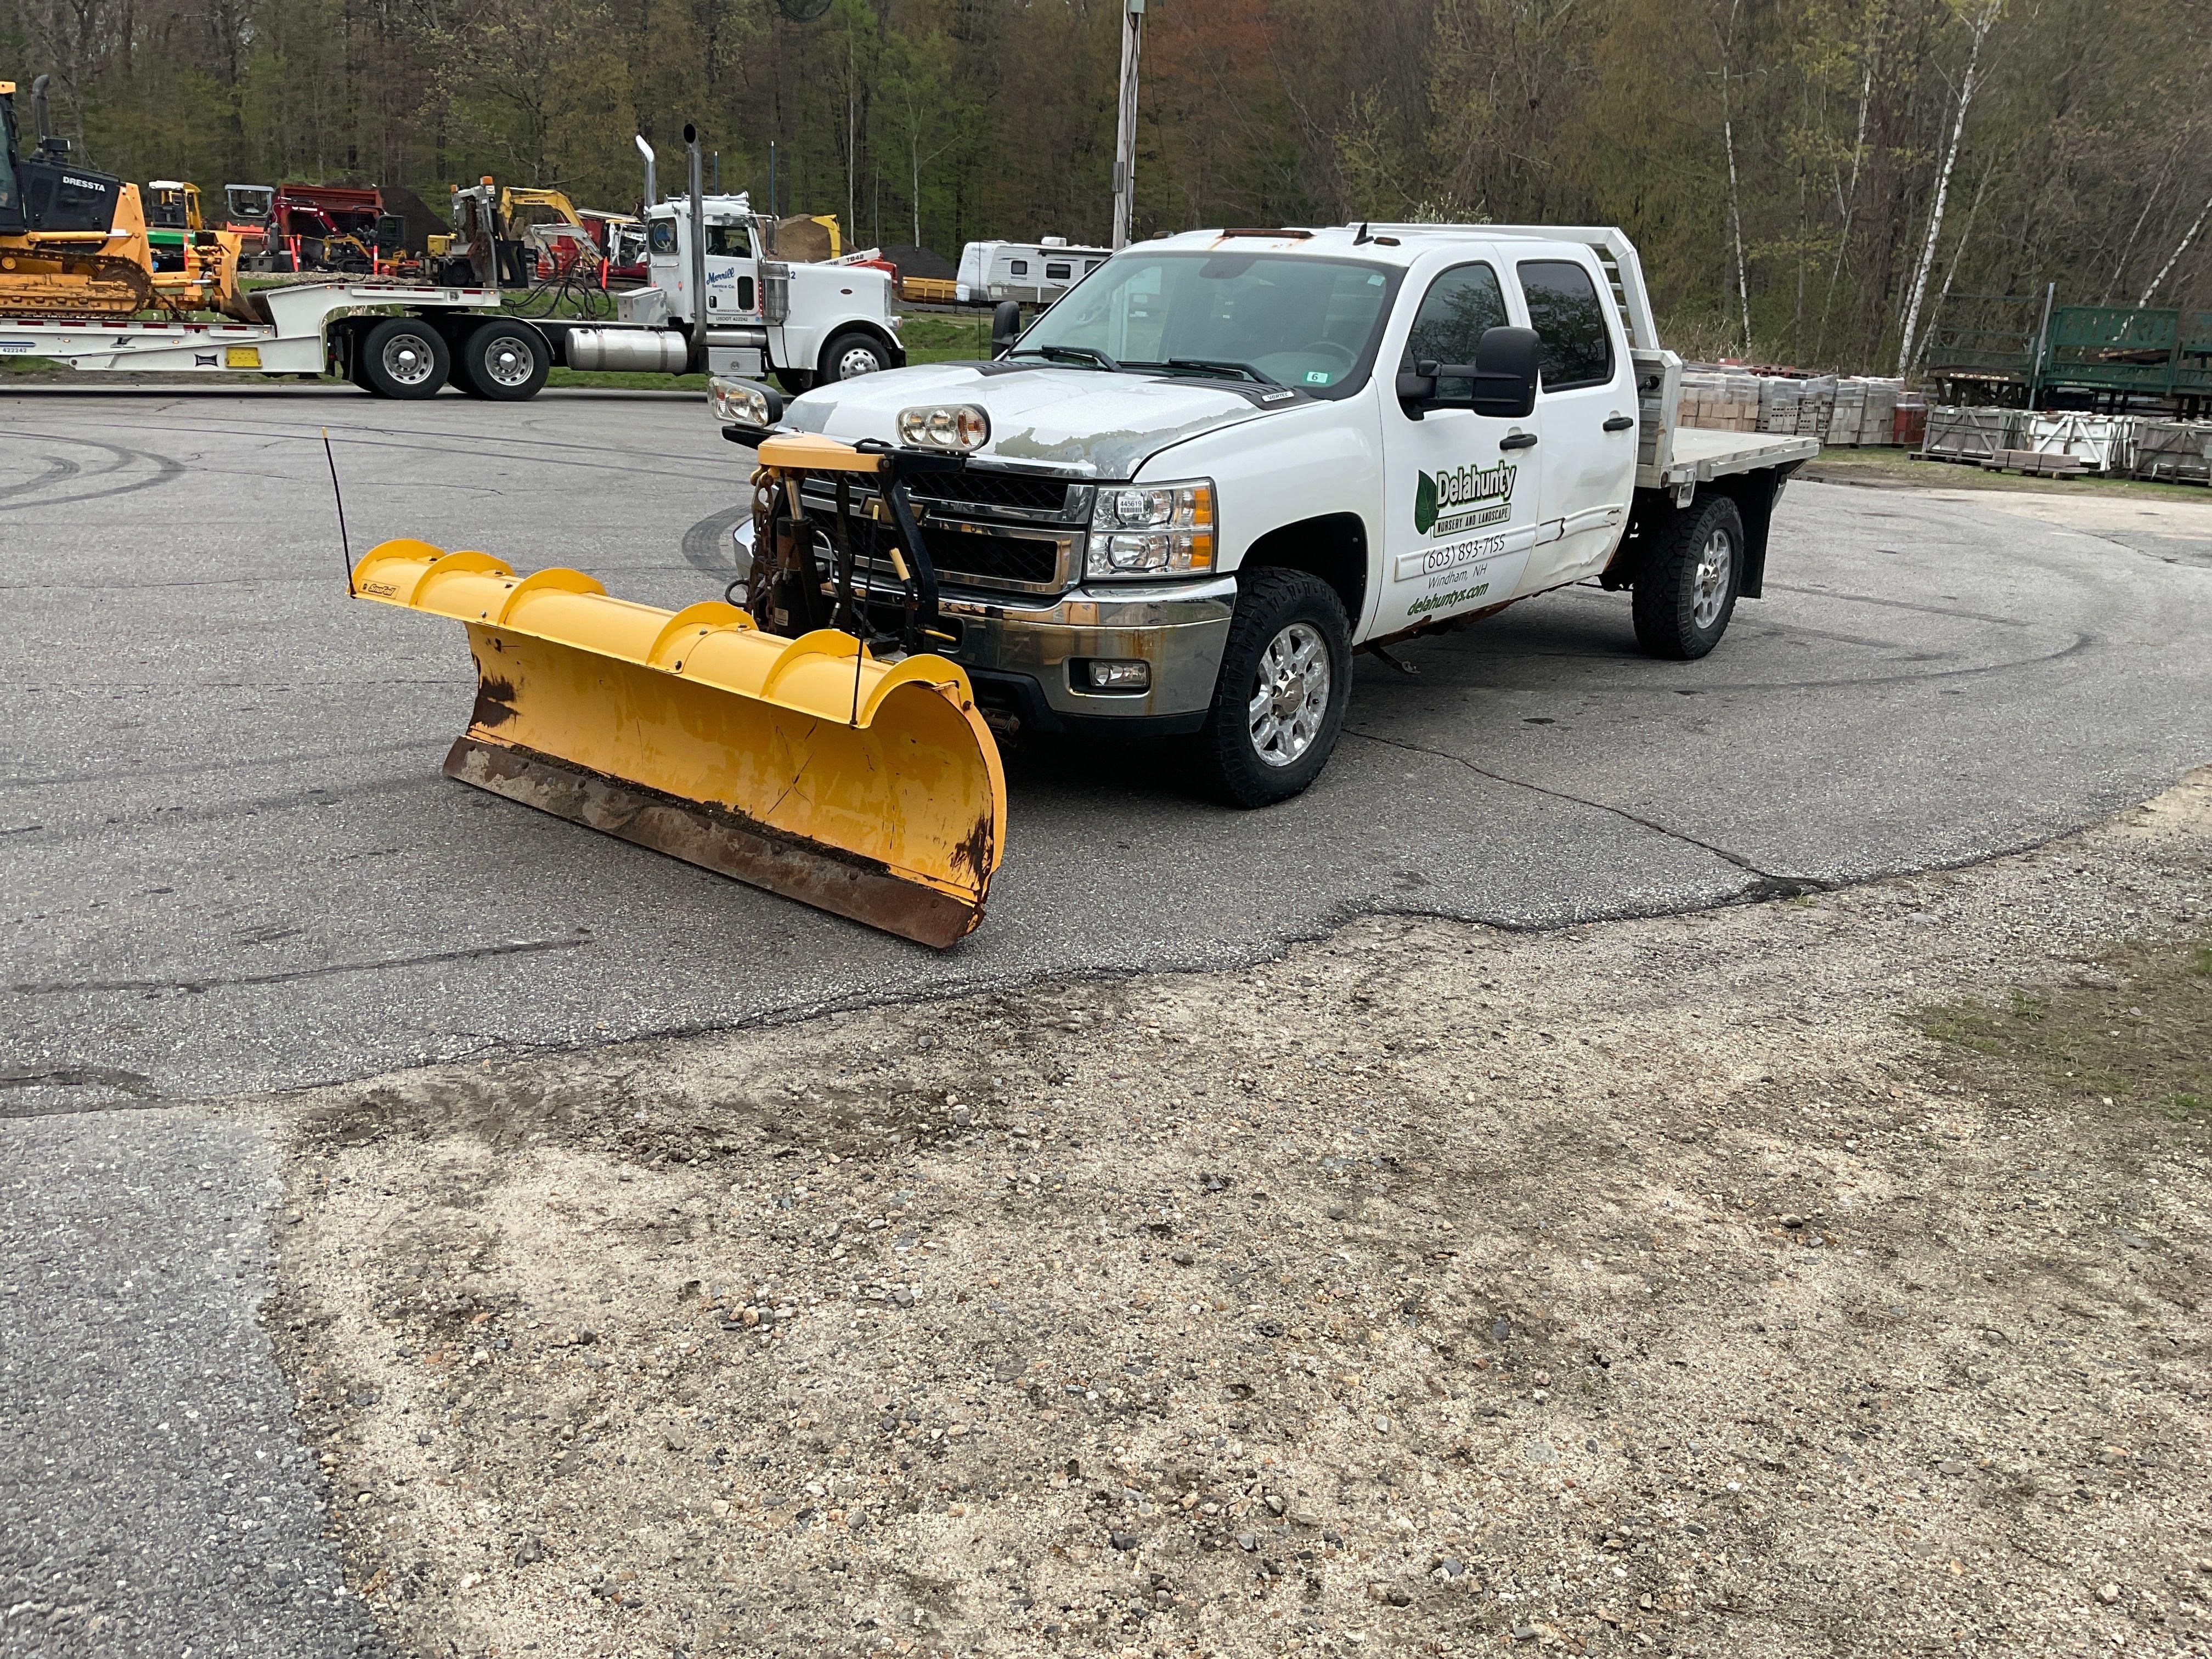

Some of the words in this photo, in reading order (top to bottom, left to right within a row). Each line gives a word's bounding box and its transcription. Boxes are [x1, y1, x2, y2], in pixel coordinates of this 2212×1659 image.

[63, 176, 106, 192] DRESSTA
[706, 267, 735, 285] Merrill
[1436, 459, 1517, 510] Delahunty
[1437, 517, 1463, 533] NURSERY
[1465, 515, 1476, 527] AND
[1478, 507, 1508, 524] LANDSCAPE
[1423, 545, 1455, 574] (603)
[1458, 533, 1506, 561] 893-7155
[1428, 570, 1468, 589] Windham,
[1472, 562, 1488, 577] NH
[1407, 583, 1489, 616] delahuntys.com
